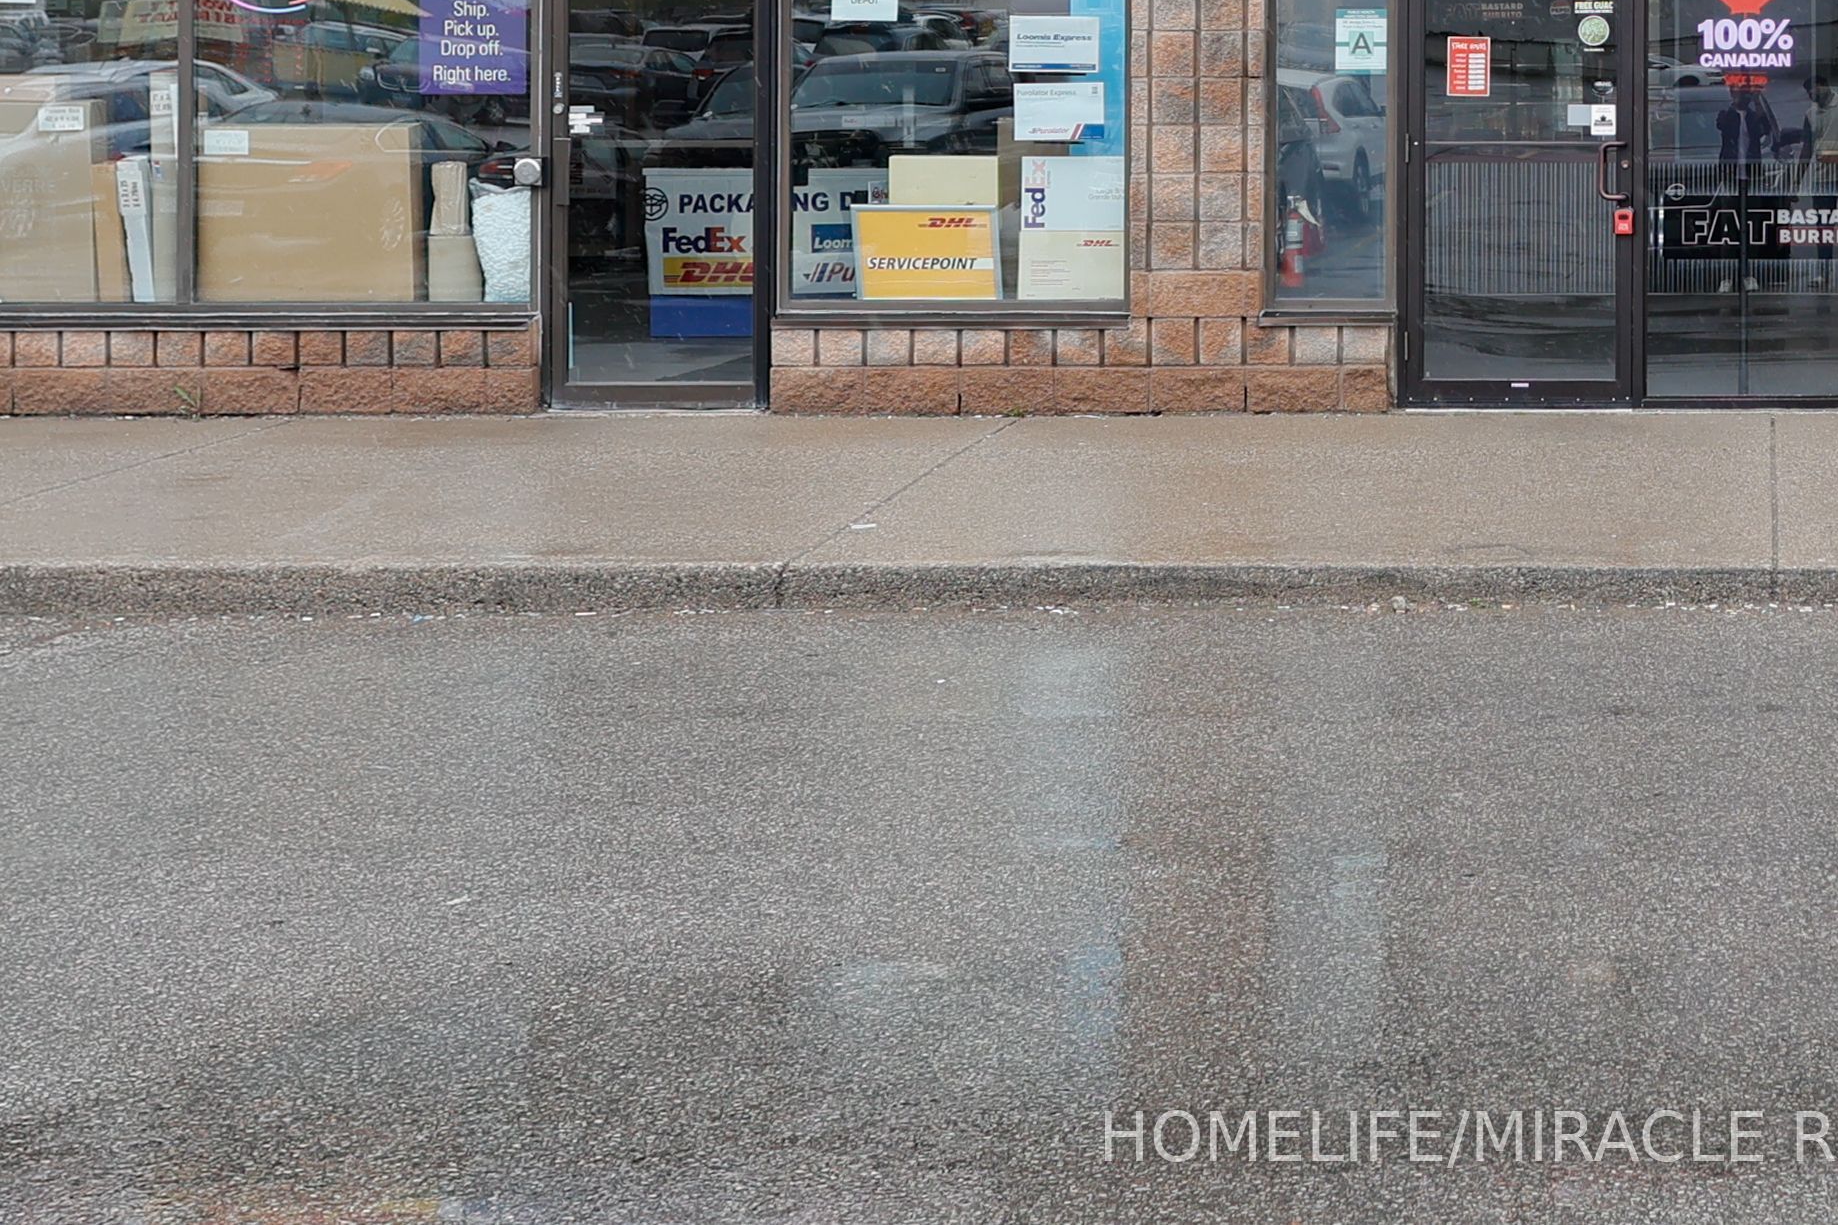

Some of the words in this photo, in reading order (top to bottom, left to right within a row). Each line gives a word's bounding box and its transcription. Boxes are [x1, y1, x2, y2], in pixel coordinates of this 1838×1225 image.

[452, 0, 491, 21] Ship.
[443, 19, 474, 37] Pick
[476, 23, 500, 40] up.
[1016, 32, 1051, 41] Loomis
[1052, 32, 1093, 43] Express
[1697, 18, 1794, 51] 100%
[440, 39, 476, 60] Drop
[478, 39, 504, 57] off.
[1350, 31, 1373, 55] A
[1699, 52, 1792, 68] CANADIAN
[432, 64, 472, 85] Right
[473, 65, 512, 82] here.
[678, 192, 830, 214] PACKANG
[1023, 159, 1046, 229] FedEx
[926, 217, 978, 228] DHL
[1681, 209, 1775, 245] FAT
[662, 226, 747, 254] FedEx
[1083, 239, 1114, 248] DHL
[868, 256, 978, 270] SERVICEPOINT
